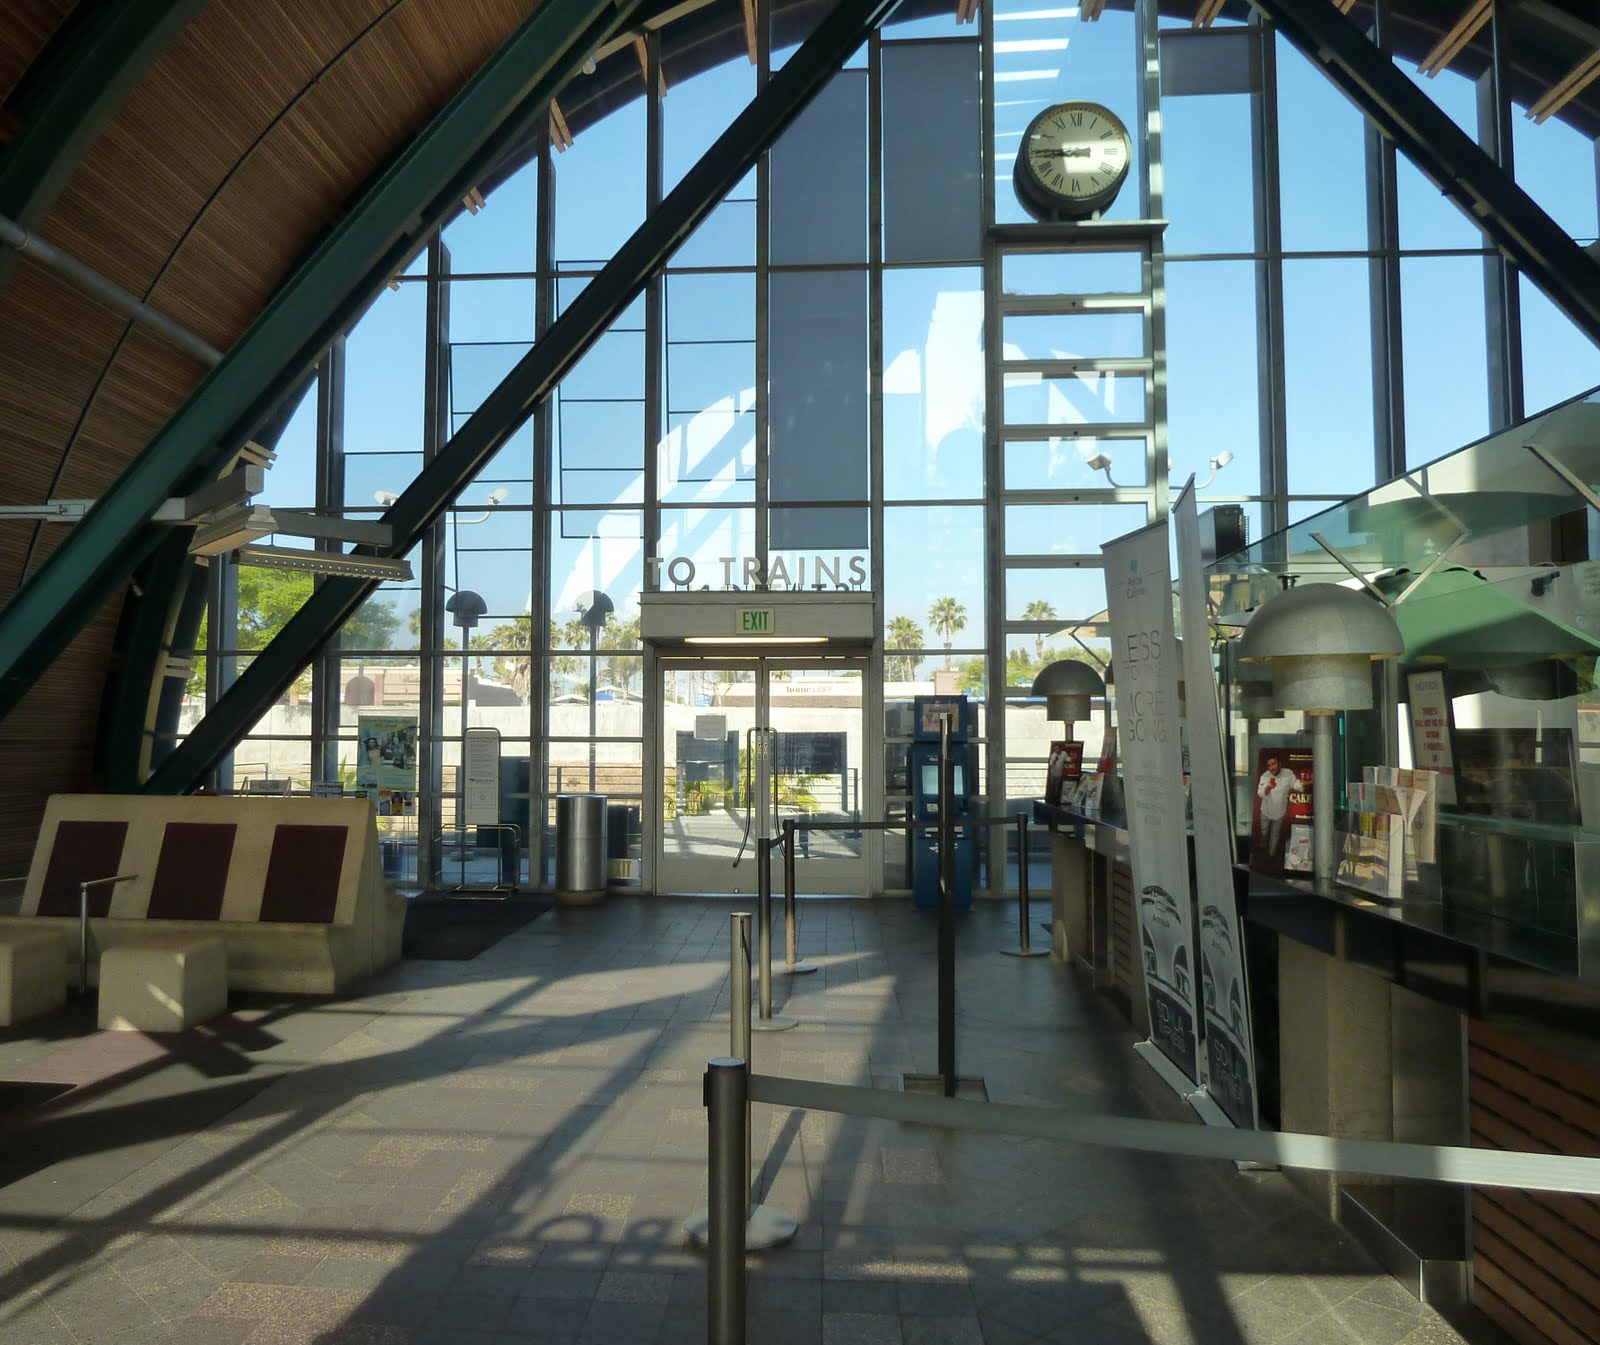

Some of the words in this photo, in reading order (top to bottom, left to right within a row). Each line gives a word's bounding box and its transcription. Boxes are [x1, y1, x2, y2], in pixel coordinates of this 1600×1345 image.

[647, 556, 696, 586] TO
[719, 555, 867, 586] TRAINS
[743, 611, 769, 631] EXIT
[1289, 793, 1313, 806] CAKE
